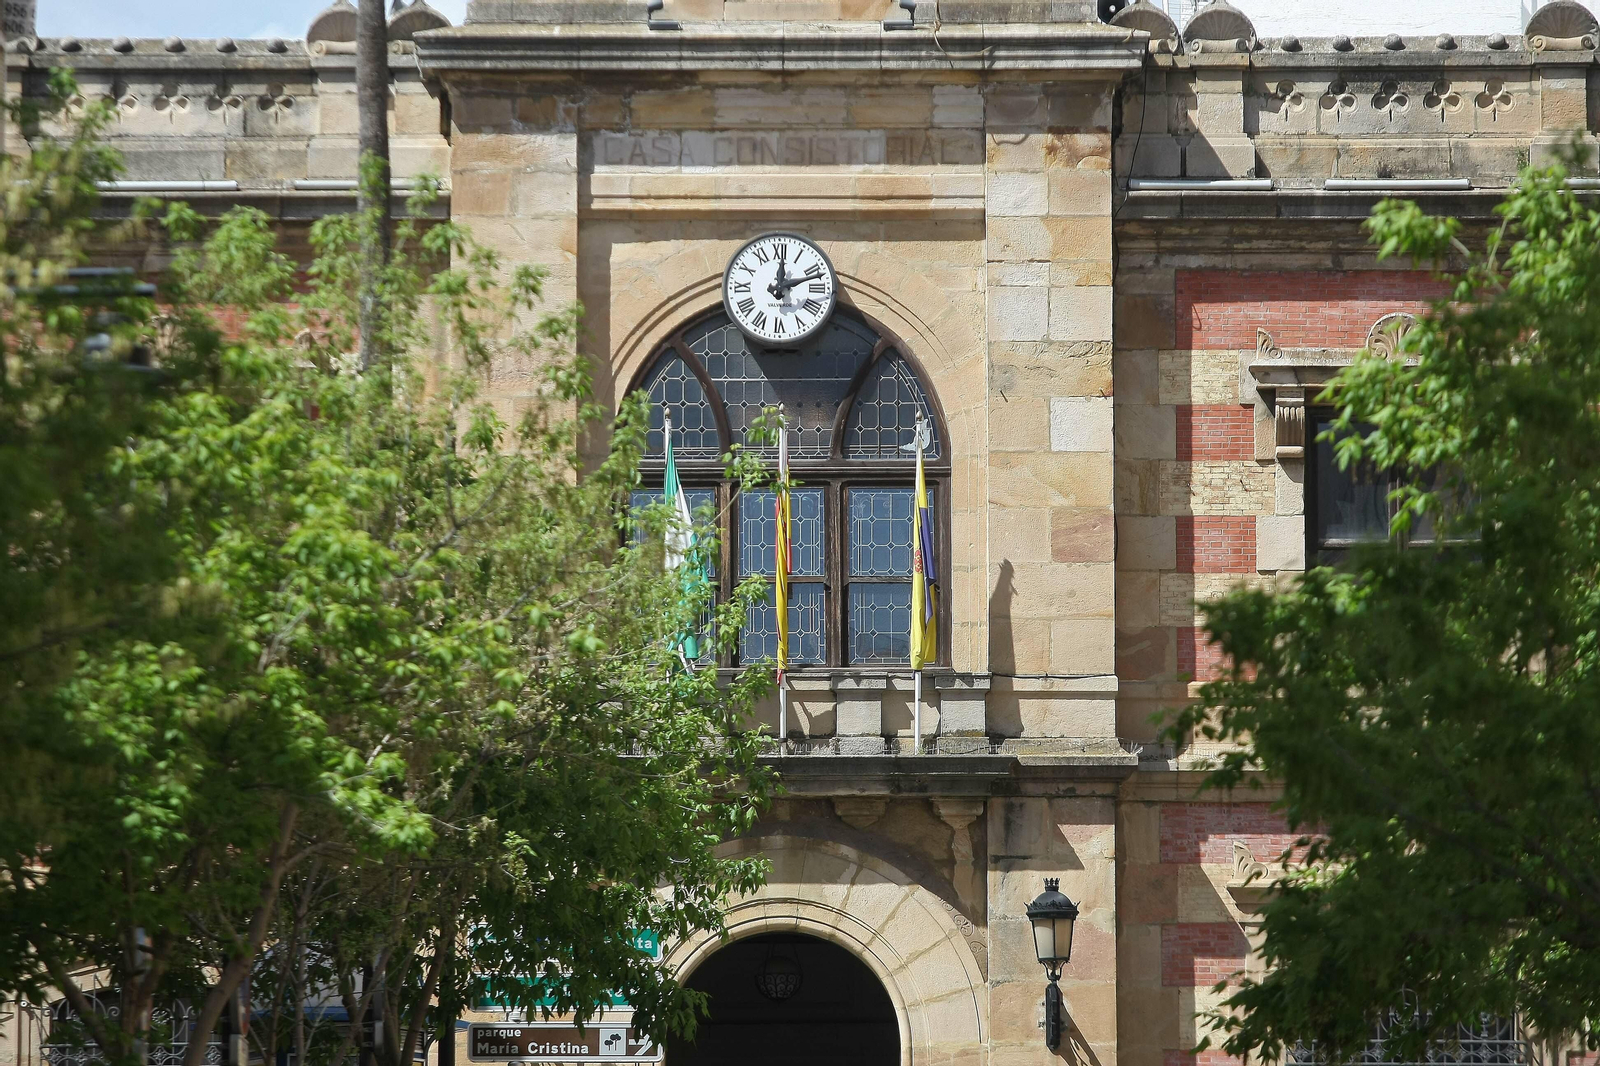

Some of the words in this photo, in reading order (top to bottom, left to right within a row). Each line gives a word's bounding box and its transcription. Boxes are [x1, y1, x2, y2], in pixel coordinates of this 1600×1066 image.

[604, 136, 696, 165] CASA
[713, 136, 960, 165] CONSISTORIAL
[477, 1029, 522, 1039] parque
[477, 1042, 519, 1054] María
[527, 1041, 589, 1054] Cristina
